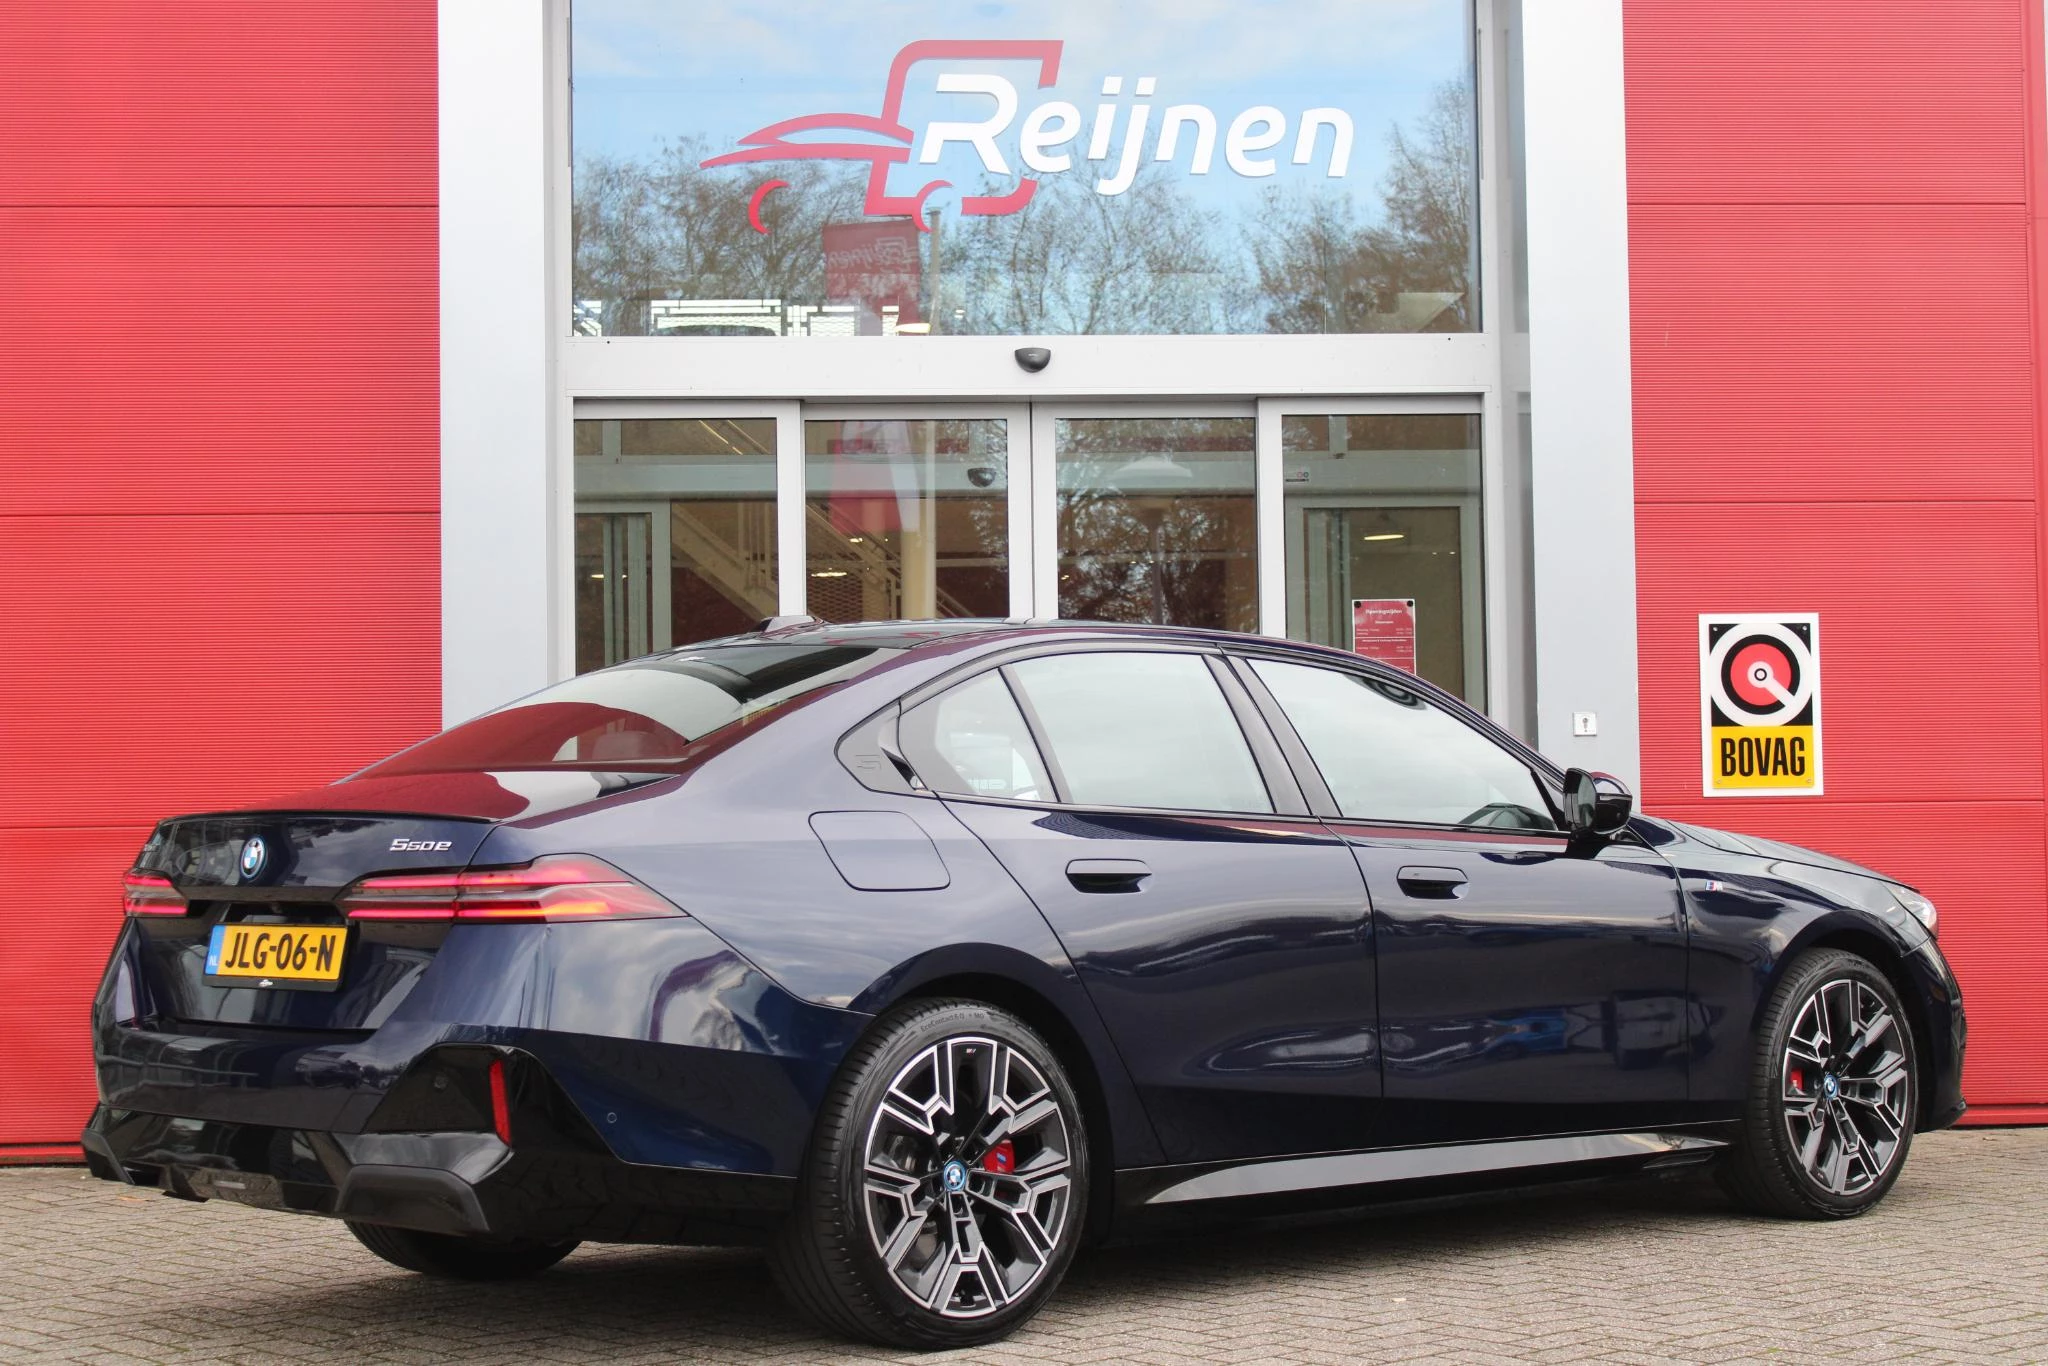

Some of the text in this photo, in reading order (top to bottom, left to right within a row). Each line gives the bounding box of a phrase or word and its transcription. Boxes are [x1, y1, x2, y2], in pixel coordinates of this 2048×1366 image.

[919, 73, 1354, 196] Reijnen
[1721, 737, 1805, 777] BOVAG
[389, 838, 453, 851] 550e
[209, 954, 219, 967] NL
[225, 932, 337, 972] JLG-06-N
